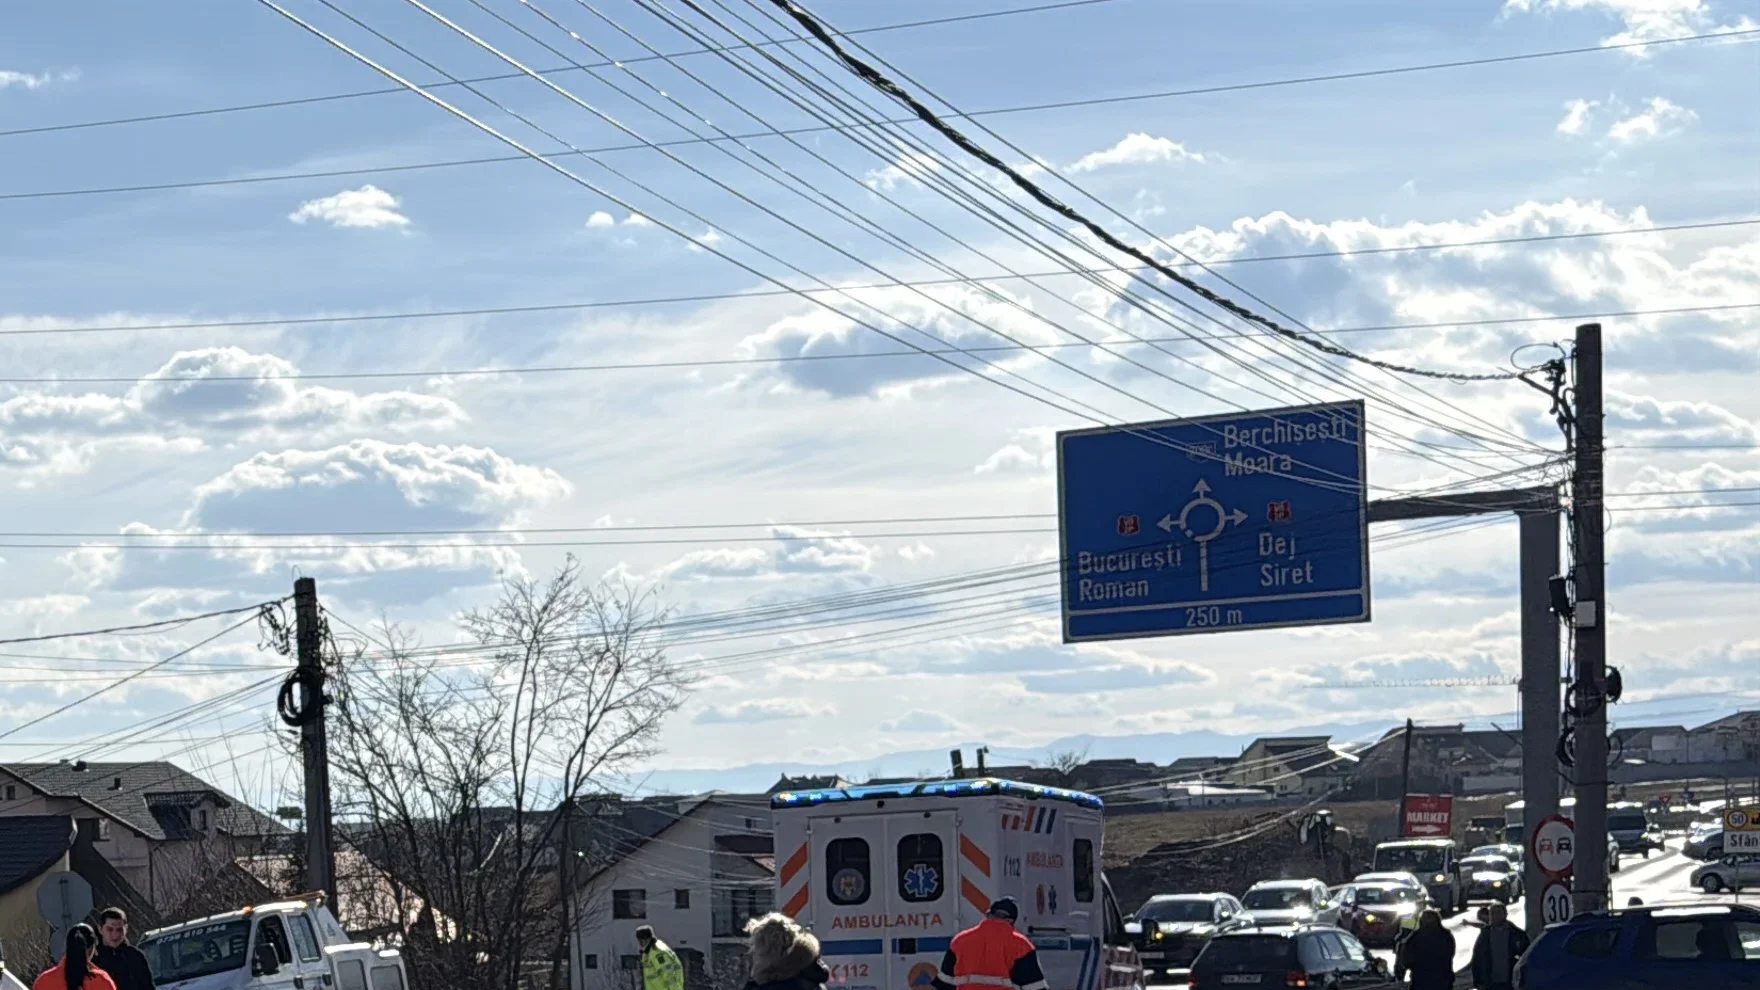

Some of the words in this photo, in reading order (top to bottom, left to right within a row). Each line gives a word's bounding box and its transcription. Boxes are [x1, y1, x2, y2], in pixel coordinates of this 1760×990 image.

[1225, 452, 1292, 477] Moara
[1259, 531, 1297, 560] Dej
[1078, 544, 1182, 576] București
[1260, 562, 1314, 588] Siret
[1079, 577, 1149, 602] Roman
[1186, 607, 1220, 626] 250
[1227, 609, 1243, 624] m
[1406, 811, 1449, 824] MARKET
[1730, 832, 1760, 848] Sfân
[1008, 856, 1022, 877] 112
[1547, 894, 1570, 923] 30
[831, 912, 944, 931] AMBULANȚA
[842, 963, 869, 978] 112
